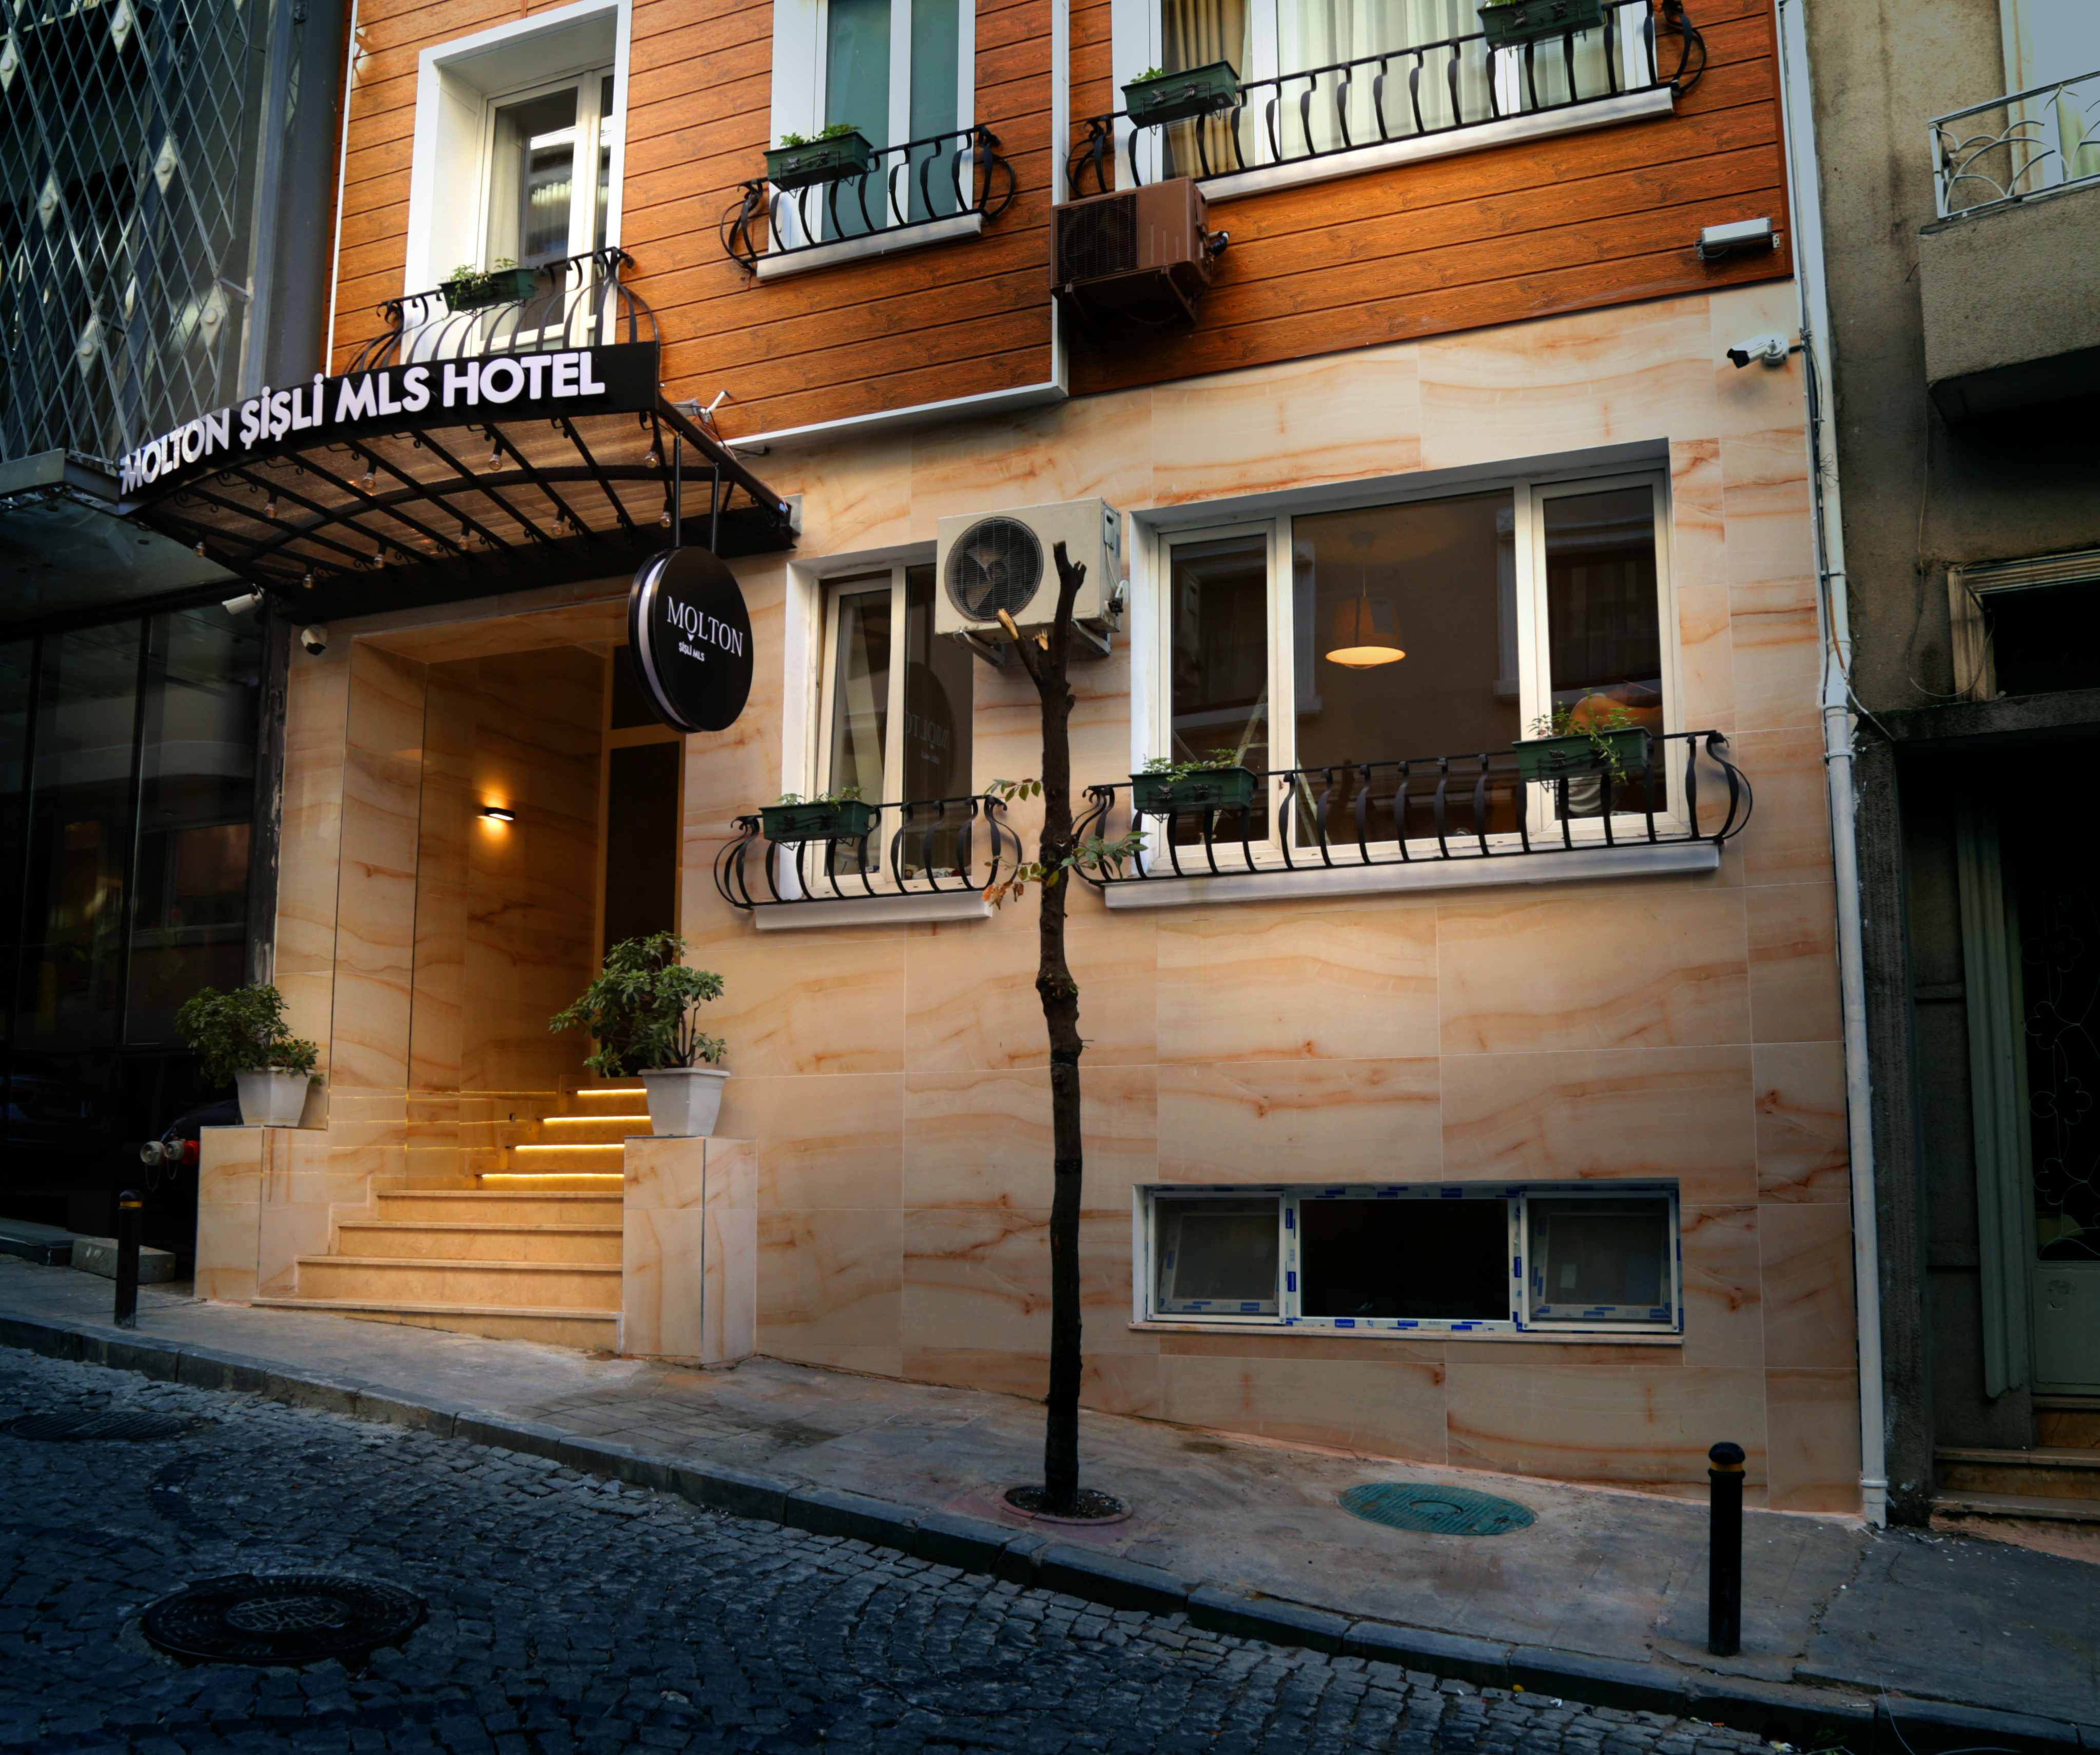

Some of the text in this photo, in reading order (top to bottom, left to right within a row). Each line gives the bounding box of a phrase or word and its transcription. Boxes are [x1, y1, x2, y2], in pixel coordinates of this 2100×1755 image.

[121, 351, 606, 495] MOLTON ŞİŞLİ MLS HOTEL
[667, 595, 743, 657] MOLTON
[678, 641, 705, 661] ŞİŞLİ MLS
[2048, 941, 2066, 956] 39
